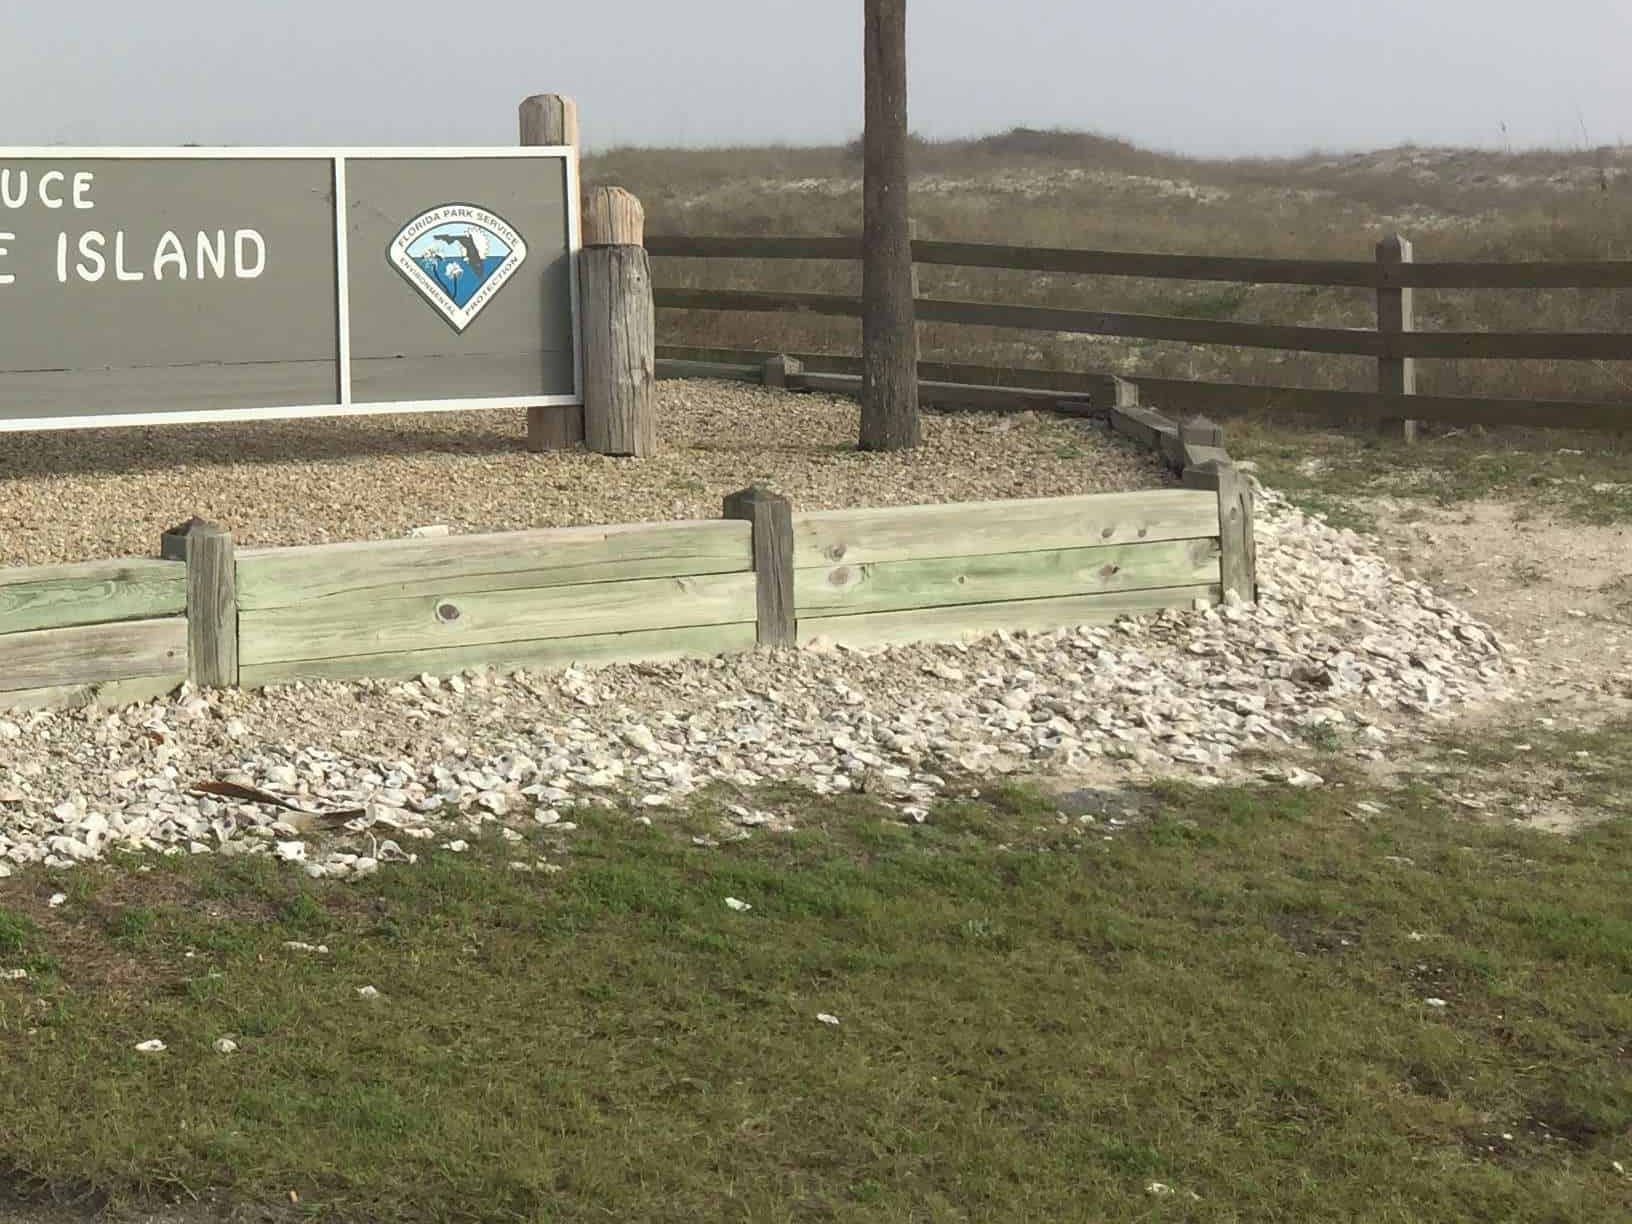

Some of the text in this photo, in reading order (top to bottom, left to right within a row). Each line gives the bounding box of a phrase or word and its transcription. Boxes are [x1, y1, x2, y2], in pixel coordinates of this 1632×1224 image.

[398, 208, 519, 248] FLORIDA PARK SERVICE
[56, 229, 266, 282] ISLAND
[465, 255, 518, 316] PROTECTION
